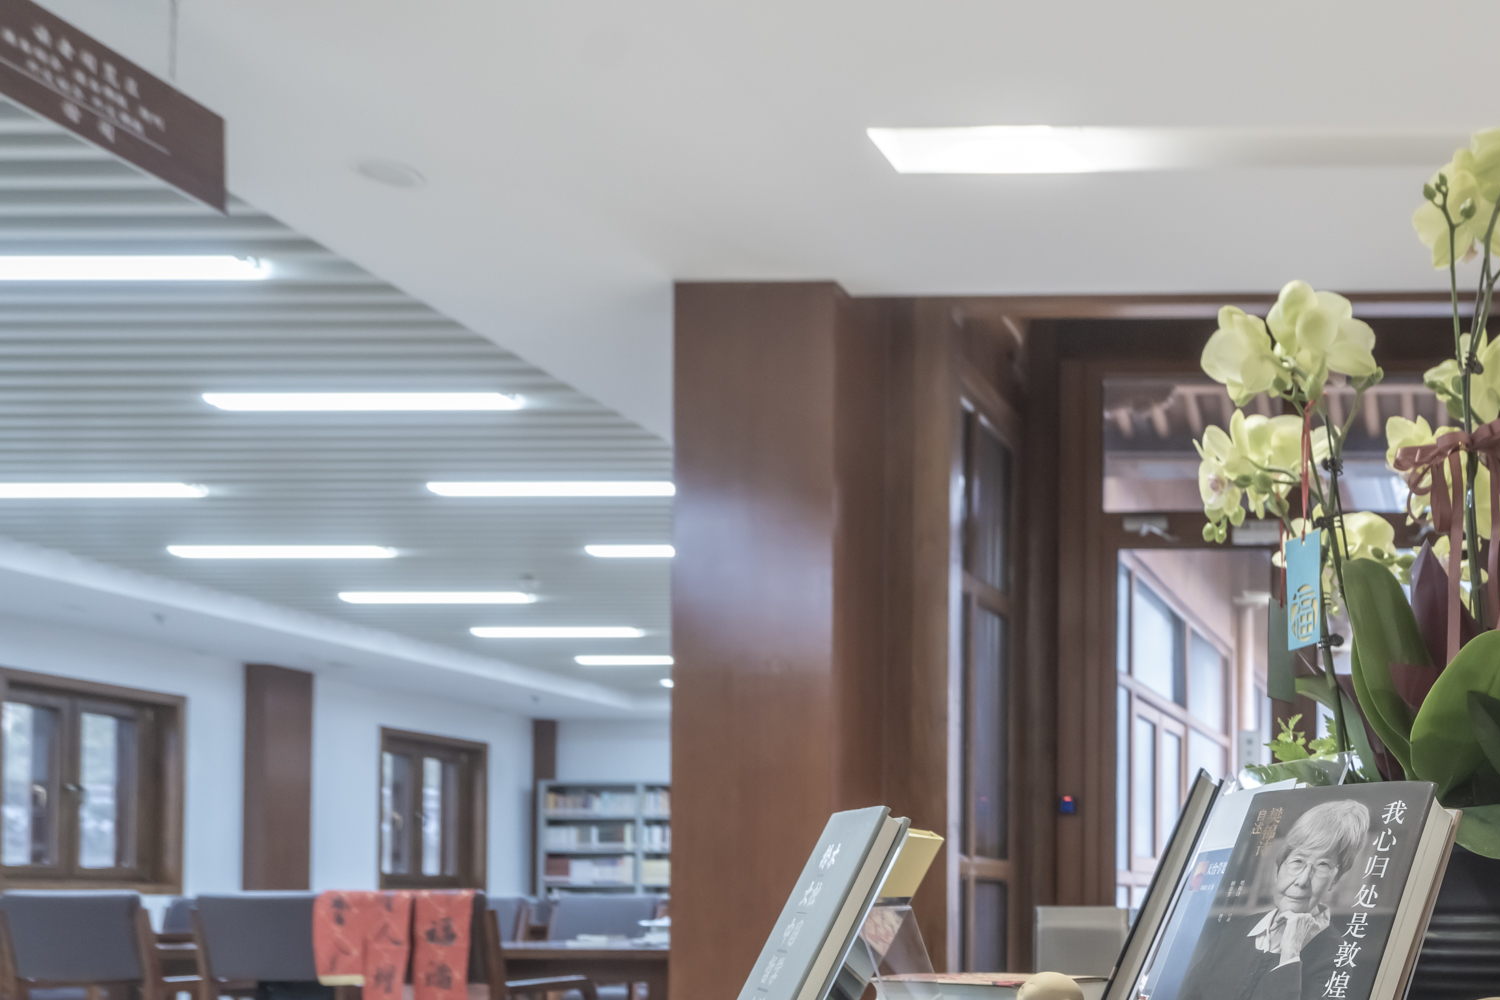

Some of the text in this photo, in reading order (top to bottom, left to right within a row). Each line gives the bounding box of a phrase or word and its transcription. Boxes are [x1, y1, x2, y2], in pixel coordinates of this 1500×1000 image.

[1251, 810, 1267, 835] 自述
[1322, 800, 1407, 999] 我心归处是敦煌
